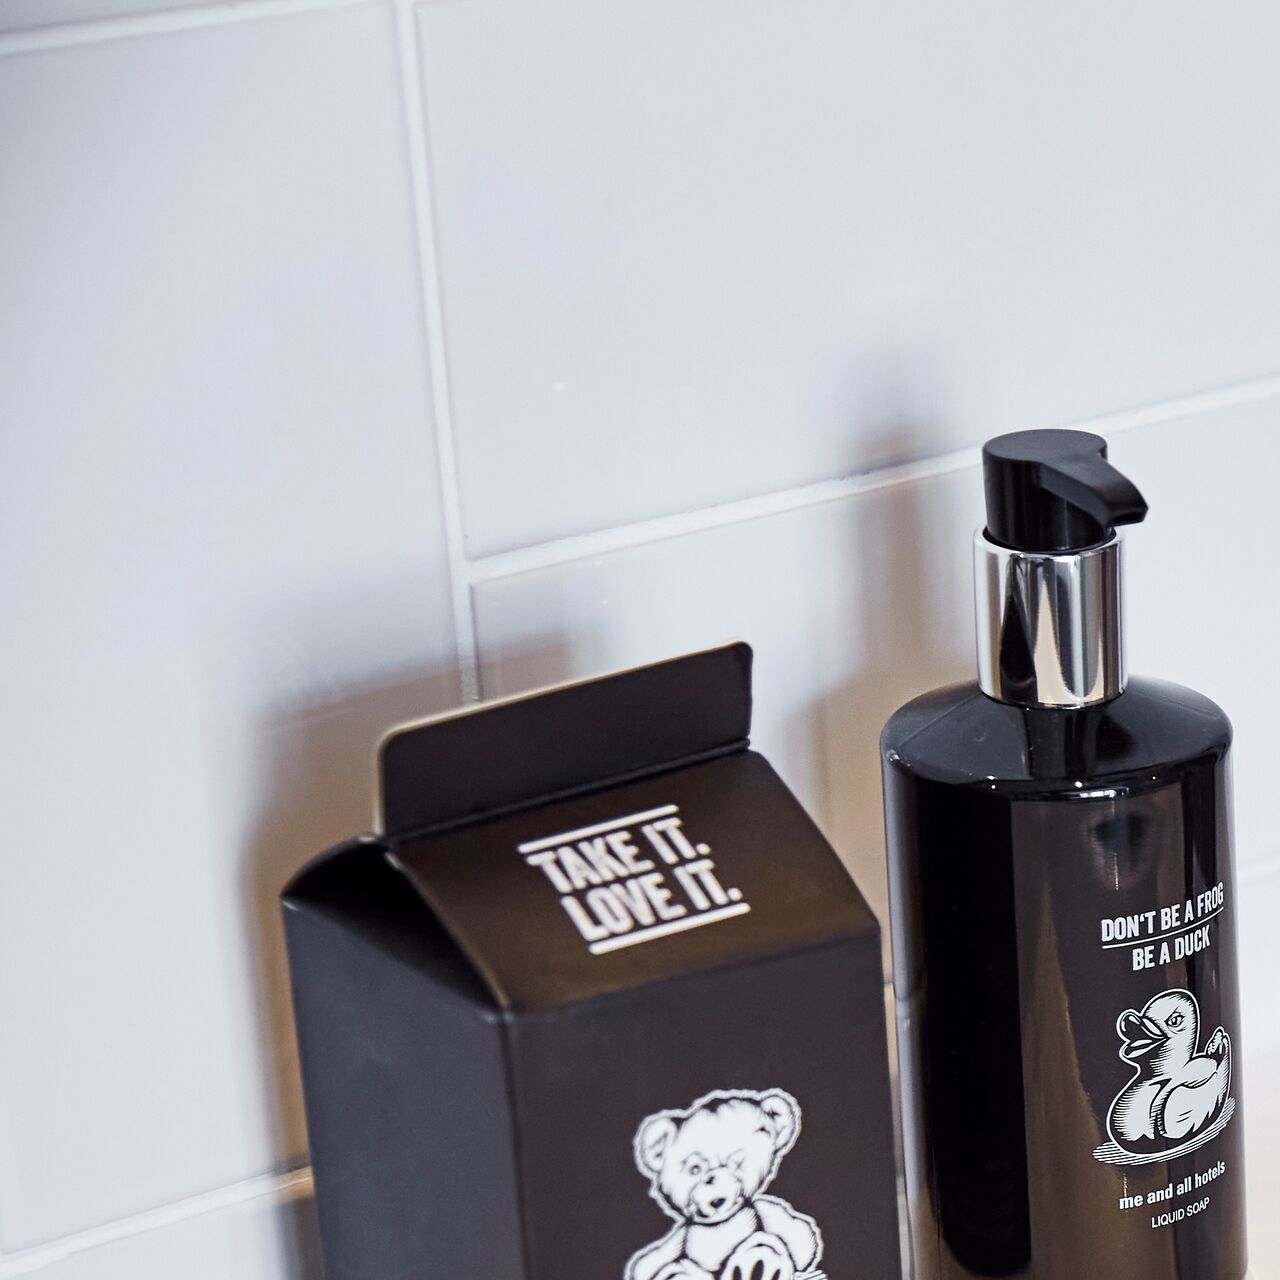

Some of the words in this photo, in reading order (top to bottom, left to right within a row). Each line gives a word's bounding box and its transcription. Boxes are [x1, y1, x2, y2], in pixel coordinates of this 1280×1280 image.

[526, 831, 655, 893] TAKE
[642, 817, 711, 864] IT.
[560, 872, 688, 941] LOVE
[674, 859, 743, 910] IT.
[1160, 903, 1181, 931] BE
[1184, 899, 1194, 923] A
[1197, 881, 1224, 918] FROG
[1132, 945, 1155, 971] BE
[1159, 941, 1171, 965] A
[1174, 924, 1211, 960] DUCK
[1119, 1195, 1143, 1209] me
[1147, 1183, 1173, 1204] and
[1176, 1176, 1192, 1196] all
[1194, 1160, 1225, 1188] hotels
[1151, 1208, 1185, 1228] LIQUID
[1186, 1197, 1210, 1217] SOAP
